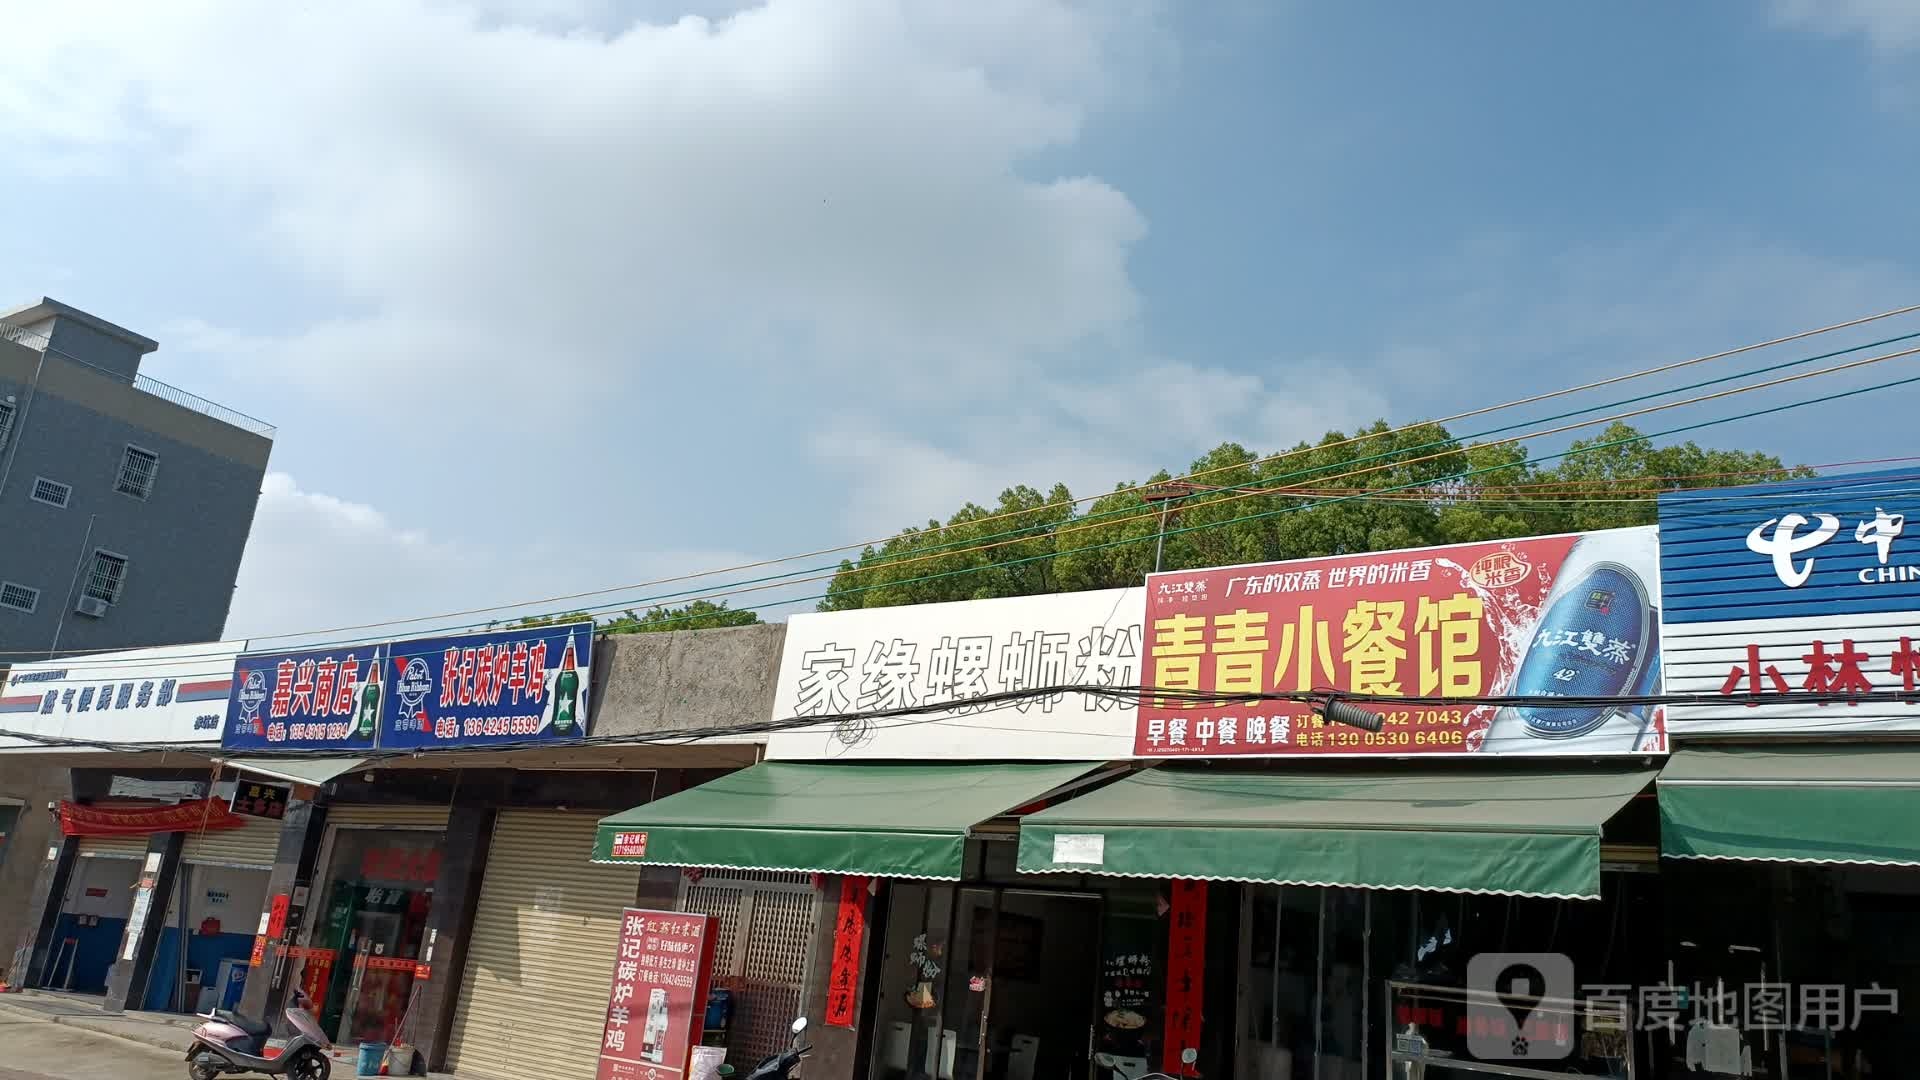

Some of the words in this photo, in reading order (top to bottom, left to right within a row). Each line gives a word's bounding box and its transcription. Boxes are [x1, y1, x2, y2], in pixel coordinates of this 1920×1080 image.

[1225, 569, 1321, 598] 广东的双蒸
[1327, 560, 1433, 589] 世界的米香
[1485, 568, 1522, 587] 米香
[1151, 594, 1483, 707] 青青小餐馆
[1532, 628, 1633, 665] 九江雙蒸
[270, 653, 359, 718] 嘉兴商店
[440, 640, 547, 708] 张记碳炉羊鸡
[794, 624, 1142, 713] 家缘螺蛳粉
[41, 679, 176, 715] 燃气便民服务部
[326, 722, 348, 739] 1234
[464, 717, 482, 737] 136
[483, 717, 510, 736] 4245
[511, 715, 538, 735] 5599
[1146, 718, 1188, 746] 早餐
[1195, 717, 1238, 745] 中餐
[1246, 716, 1291, 745] 晚餐
[1296, 713, 1325, 728] 订餐
[1415, 711, 1462, 725] 7043
[1296, 732, 1324, 747] 电话
[1327, 732, 1359, 746] 130
[1364, 732, 1409, 745] 0530
[1415, 731, 1462, 745] 6406
[606, 915, 645, 1052] 张记碳炉羊鸡
